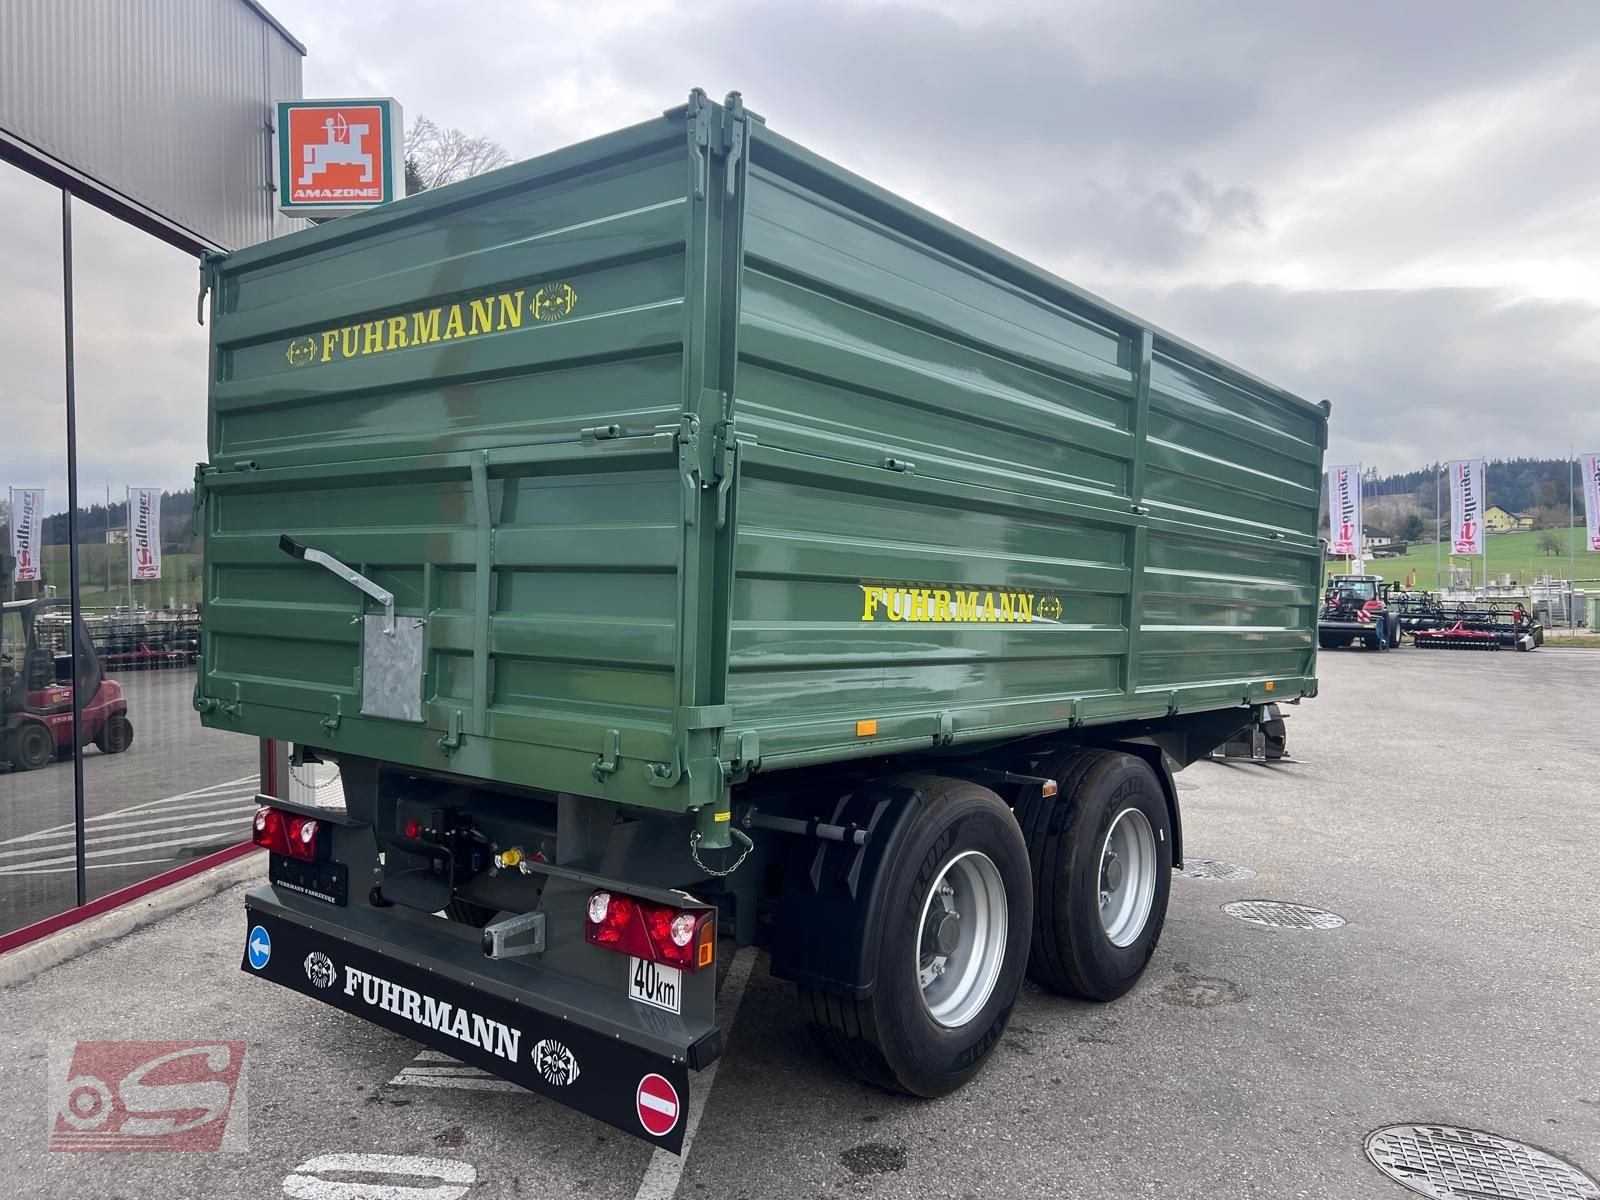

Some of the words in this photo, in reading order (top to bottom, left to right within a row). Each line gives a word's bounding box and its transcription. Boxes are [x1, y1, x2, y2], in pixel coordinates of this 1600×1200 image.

[294, 188, 379, 198] AMAZONE
[320, 291, 525, 362] FUHRMANN
[861, 586, 1034, 622] FUHRMANN
[277, 880, 304, 893] FUHRMANN
[343, 965, 521, 1063] FUHRMANN
